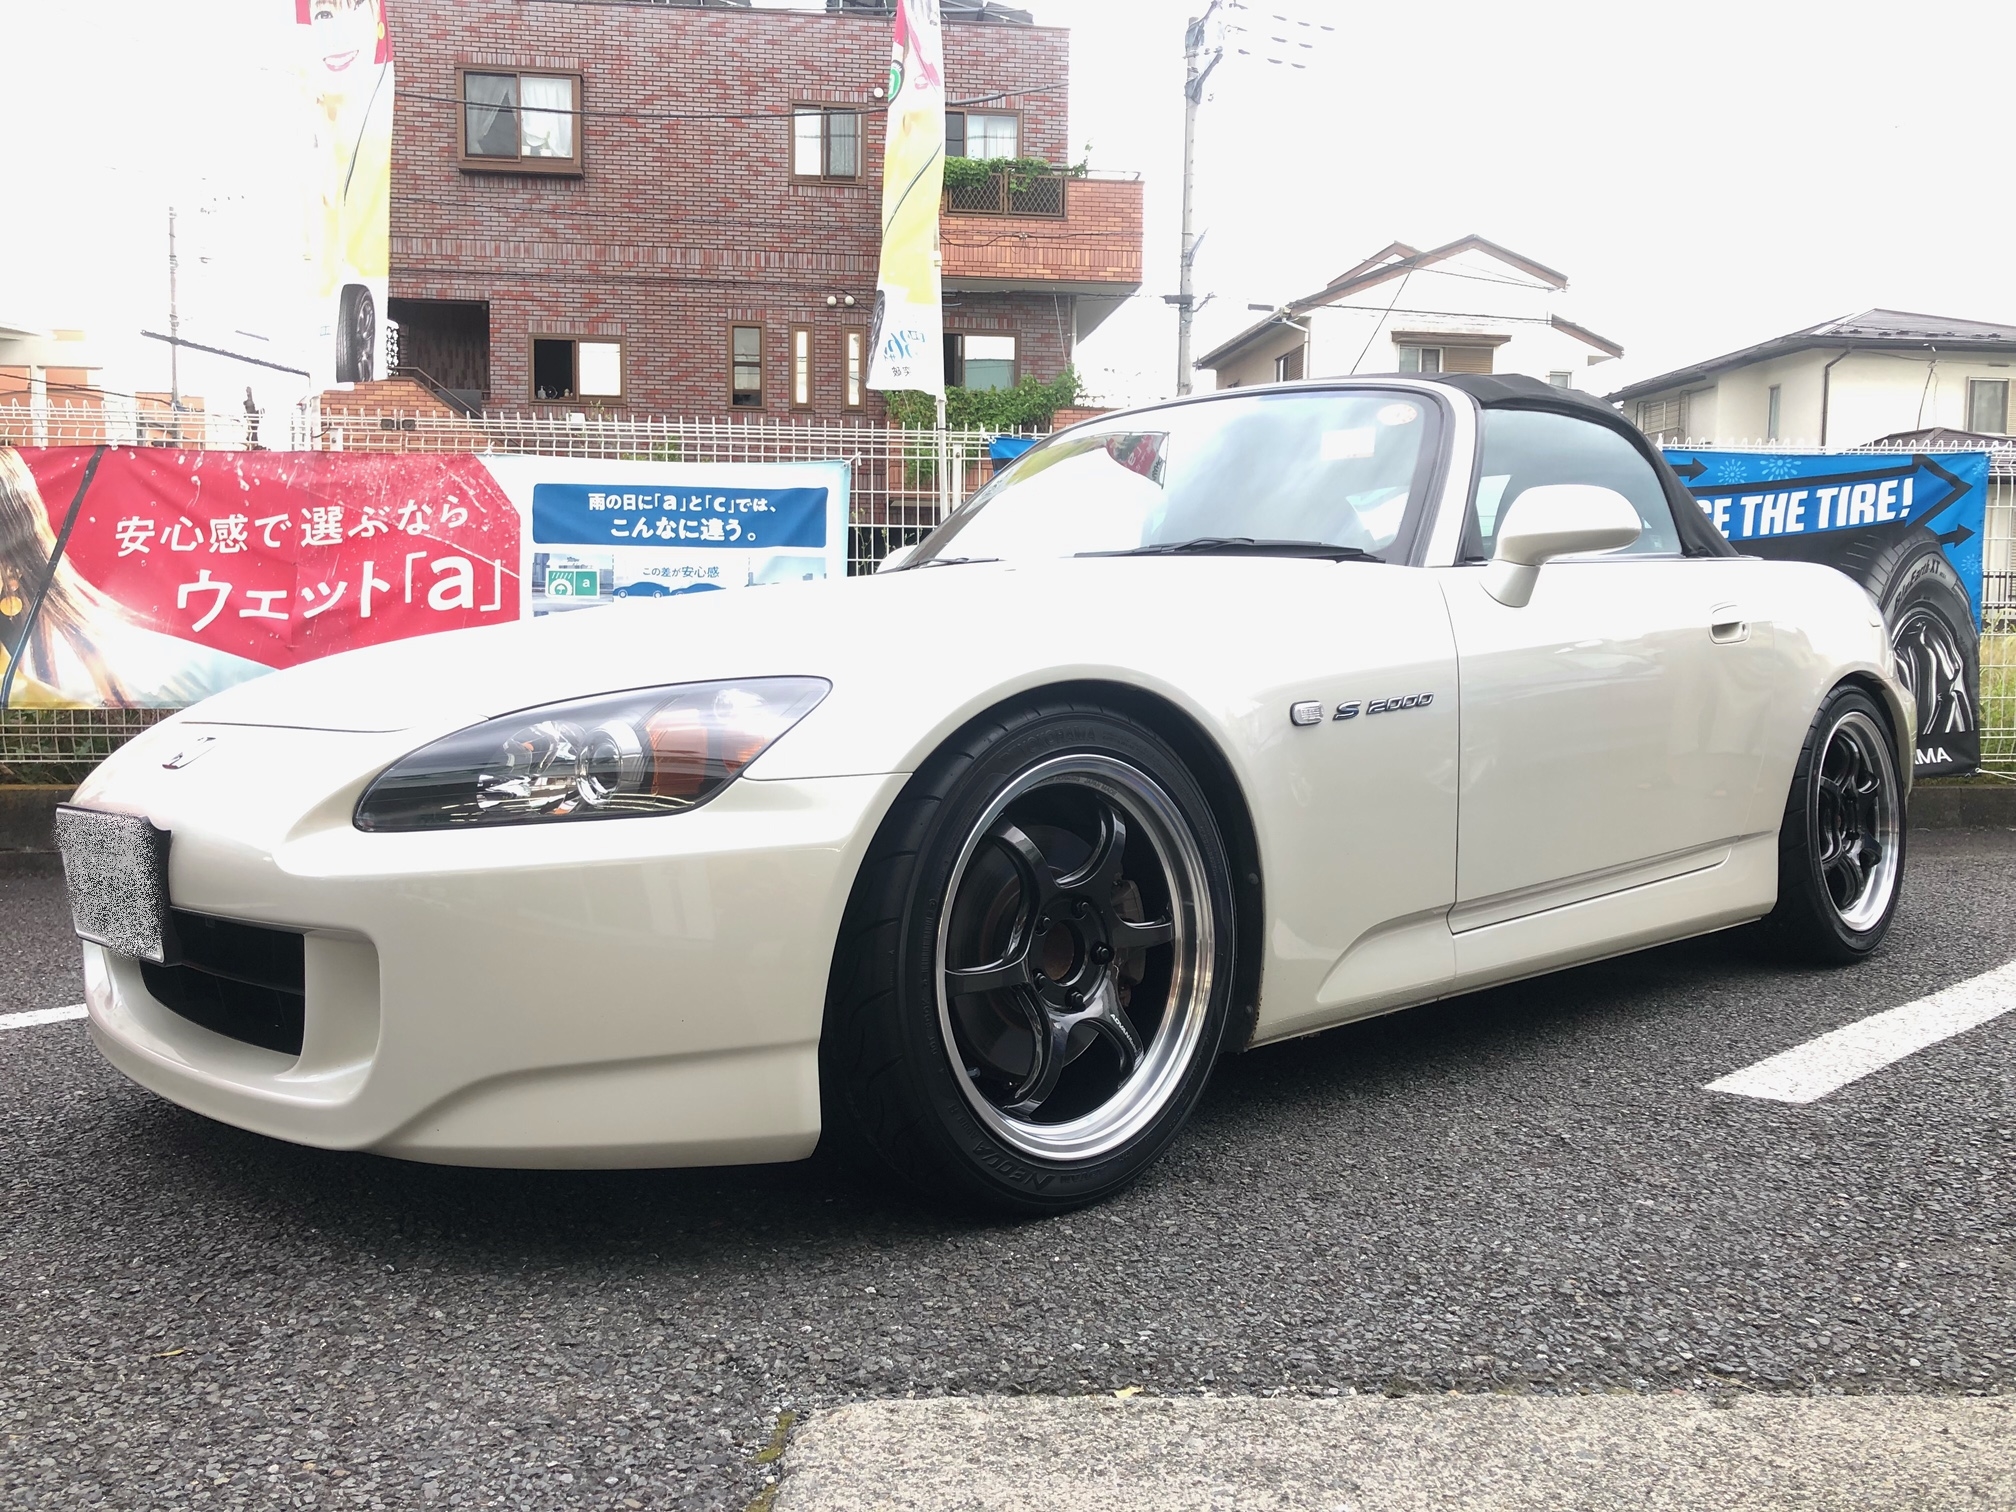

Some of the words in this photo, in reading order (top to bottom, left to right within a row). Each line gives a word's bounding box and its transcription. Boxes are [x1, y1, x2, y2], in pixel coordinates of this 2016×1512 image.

[588, 493, 777, 514] 雨の日に「a」と「c」では、
[1740, 490, 1809, 537] THE
[1816, 477, 1914, 529] TIRE!
[114, 495, 469, 557] 安心感で選ぶなら
[610, 517, 757, 541] こんなに違う。
[642, 565, 720, 578] この差が安心感
[582, 578, 591, 588] a
[1914, 747, 1953, 765] MA
